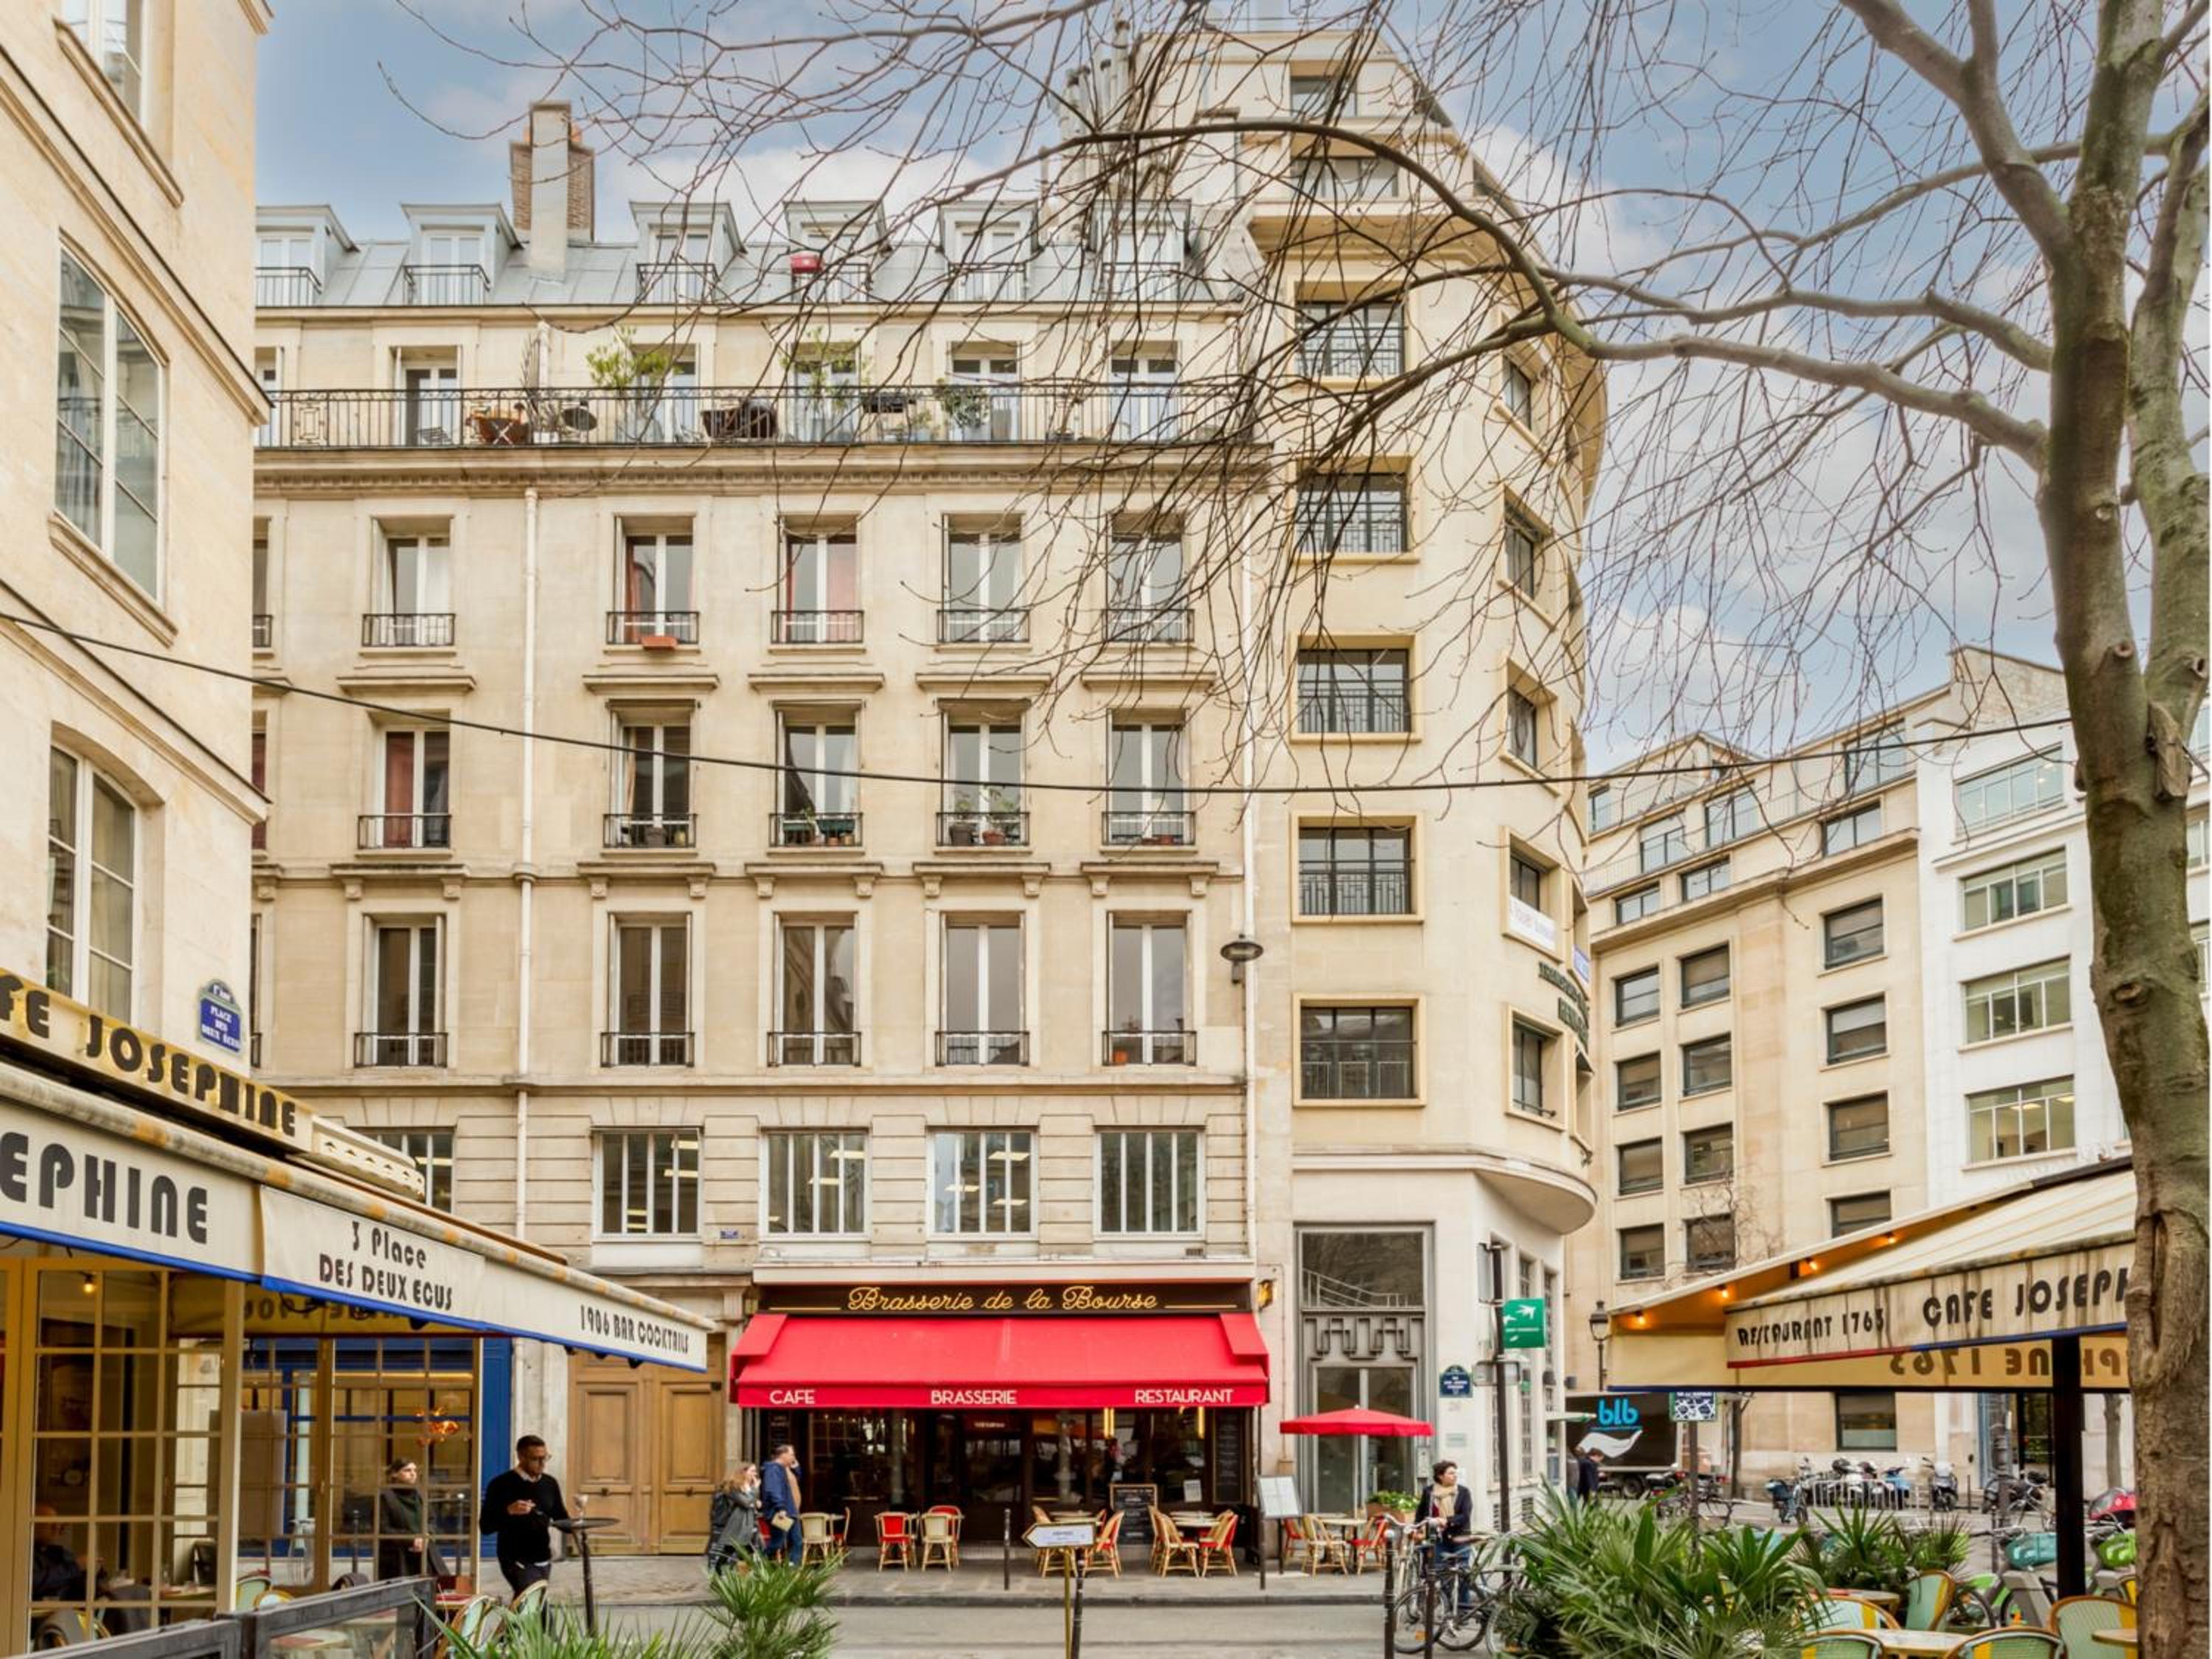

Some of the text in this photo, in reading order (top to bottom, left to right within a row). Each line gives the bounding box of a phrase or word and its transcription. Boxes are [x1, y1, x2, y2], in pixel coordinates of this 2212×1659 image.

[210, 1006, 232, 1023] PLACE
[86, 1015, 295, 1137] JOSEPHINE
[0, 1132, 207, 1245] EPHINE
[352, 1221, 426, 1269] 3 Place
[319, 1253, 452, 1311] DES DEUX ECUS
[848, 1285, 1158, 1310] Brasserie de la Bourse
[580, 1304, 689, 1354] 1906 BAR COCKTAILS
[1923, 1289, 1992, 1327] CAFE
[1737, 1315, 1832, 1346] RESTAURANT
[770, 1389, 1233, 1405] CAFE BRASSERIE RESTAURANT
